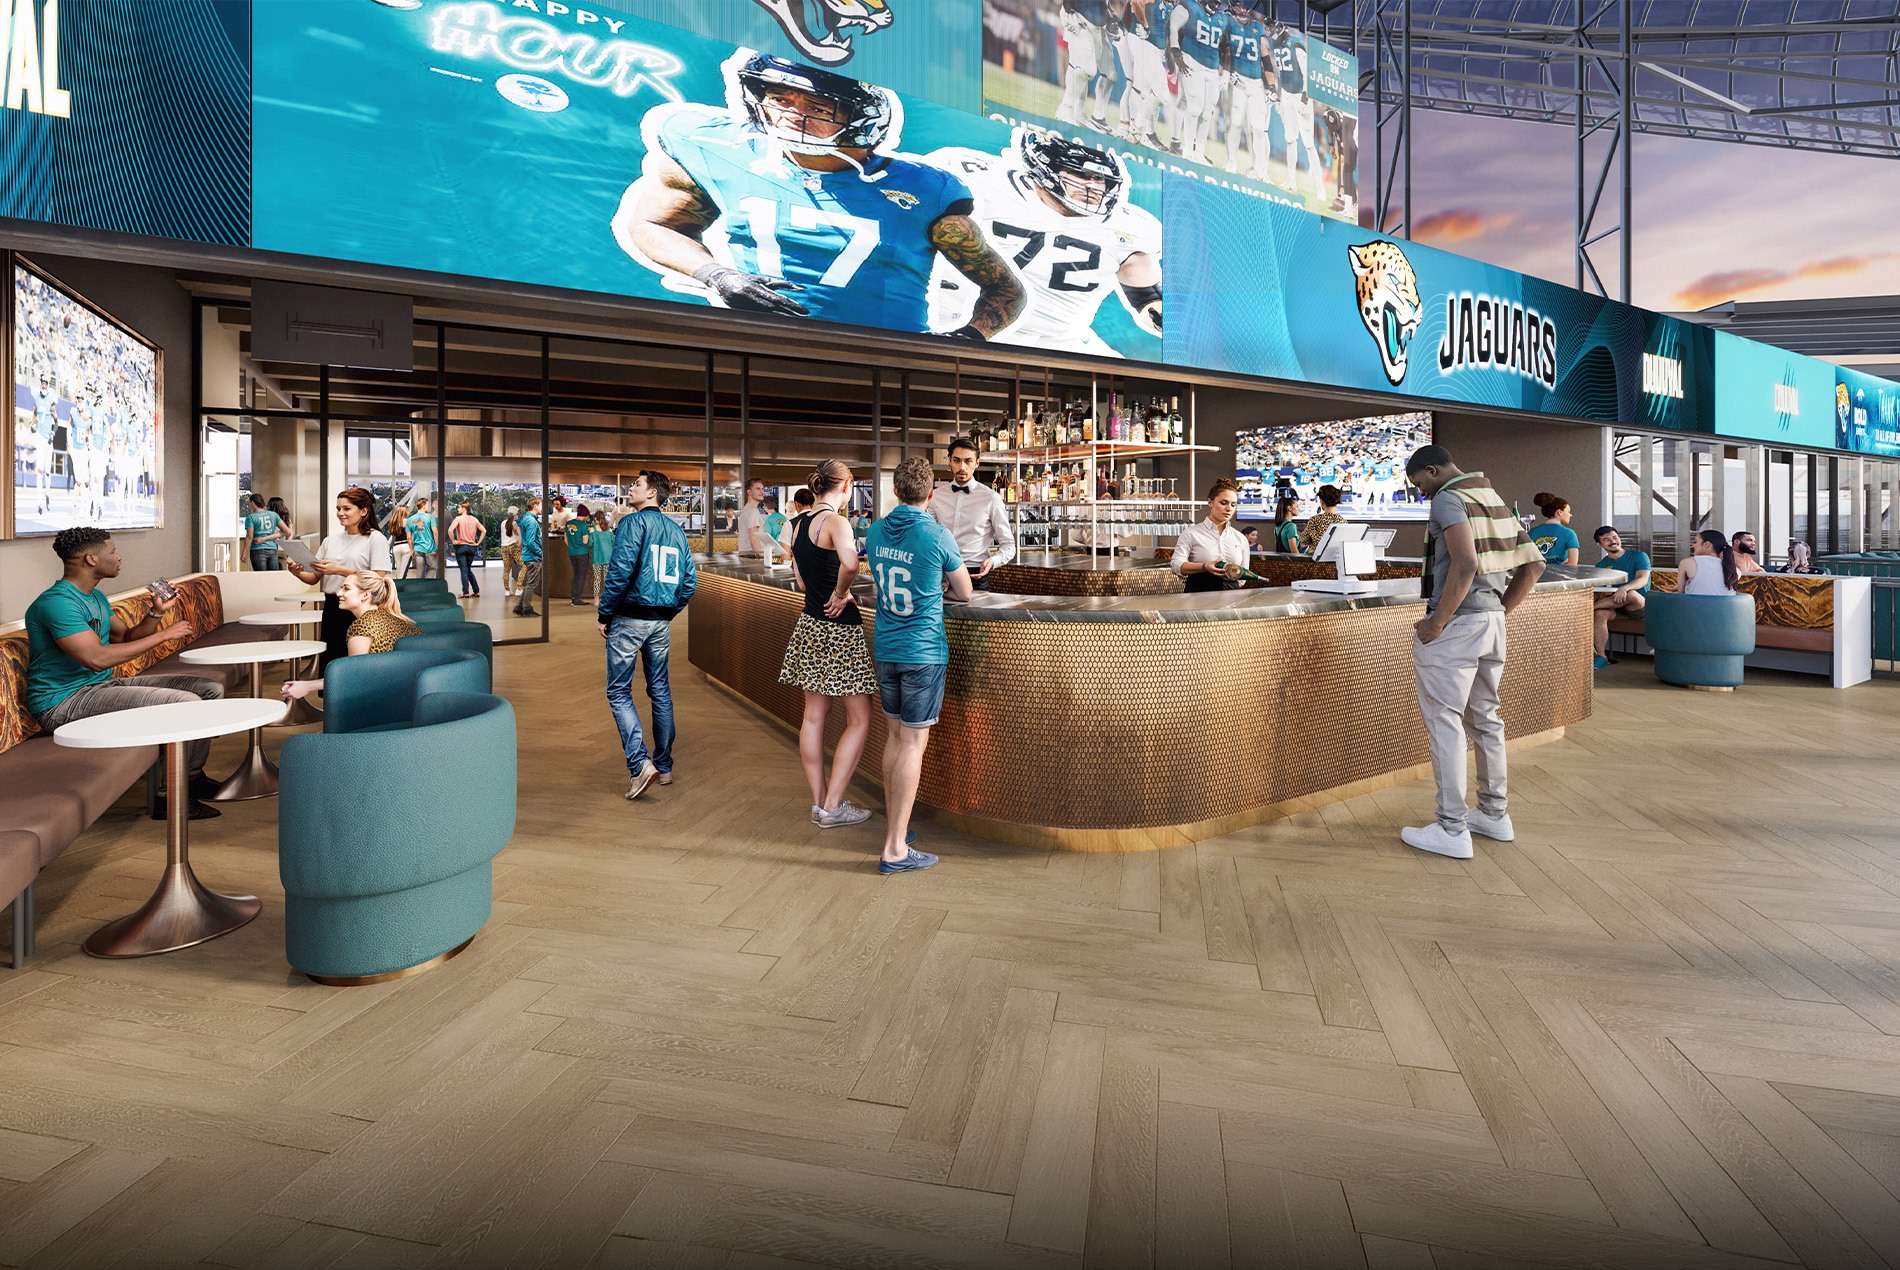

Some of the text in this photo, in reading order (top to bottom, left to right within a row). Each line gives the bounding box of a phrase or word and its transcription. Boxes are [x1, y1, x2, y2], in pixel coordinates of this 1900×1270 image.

[496, 0, 625, 34] APPY
[1196, 20, 1222, 48] 60
[1230, 33, 1259, 61] 73
[1322, 50, 1349, 70] LOCKED
[1310, 70, 1358, 99] JAGUARS
[1315, 83, 1355, 103] PODCAST
[739, 195, 881, 288] 17
[992, 220, 1102, 292] 72
[1440, 298, 1555, 388] JAGUARS
[650, 544, 680, 584] 10
[875, 545, 914, 565] LUREENCE
[875, 562, 914, 617] 16
